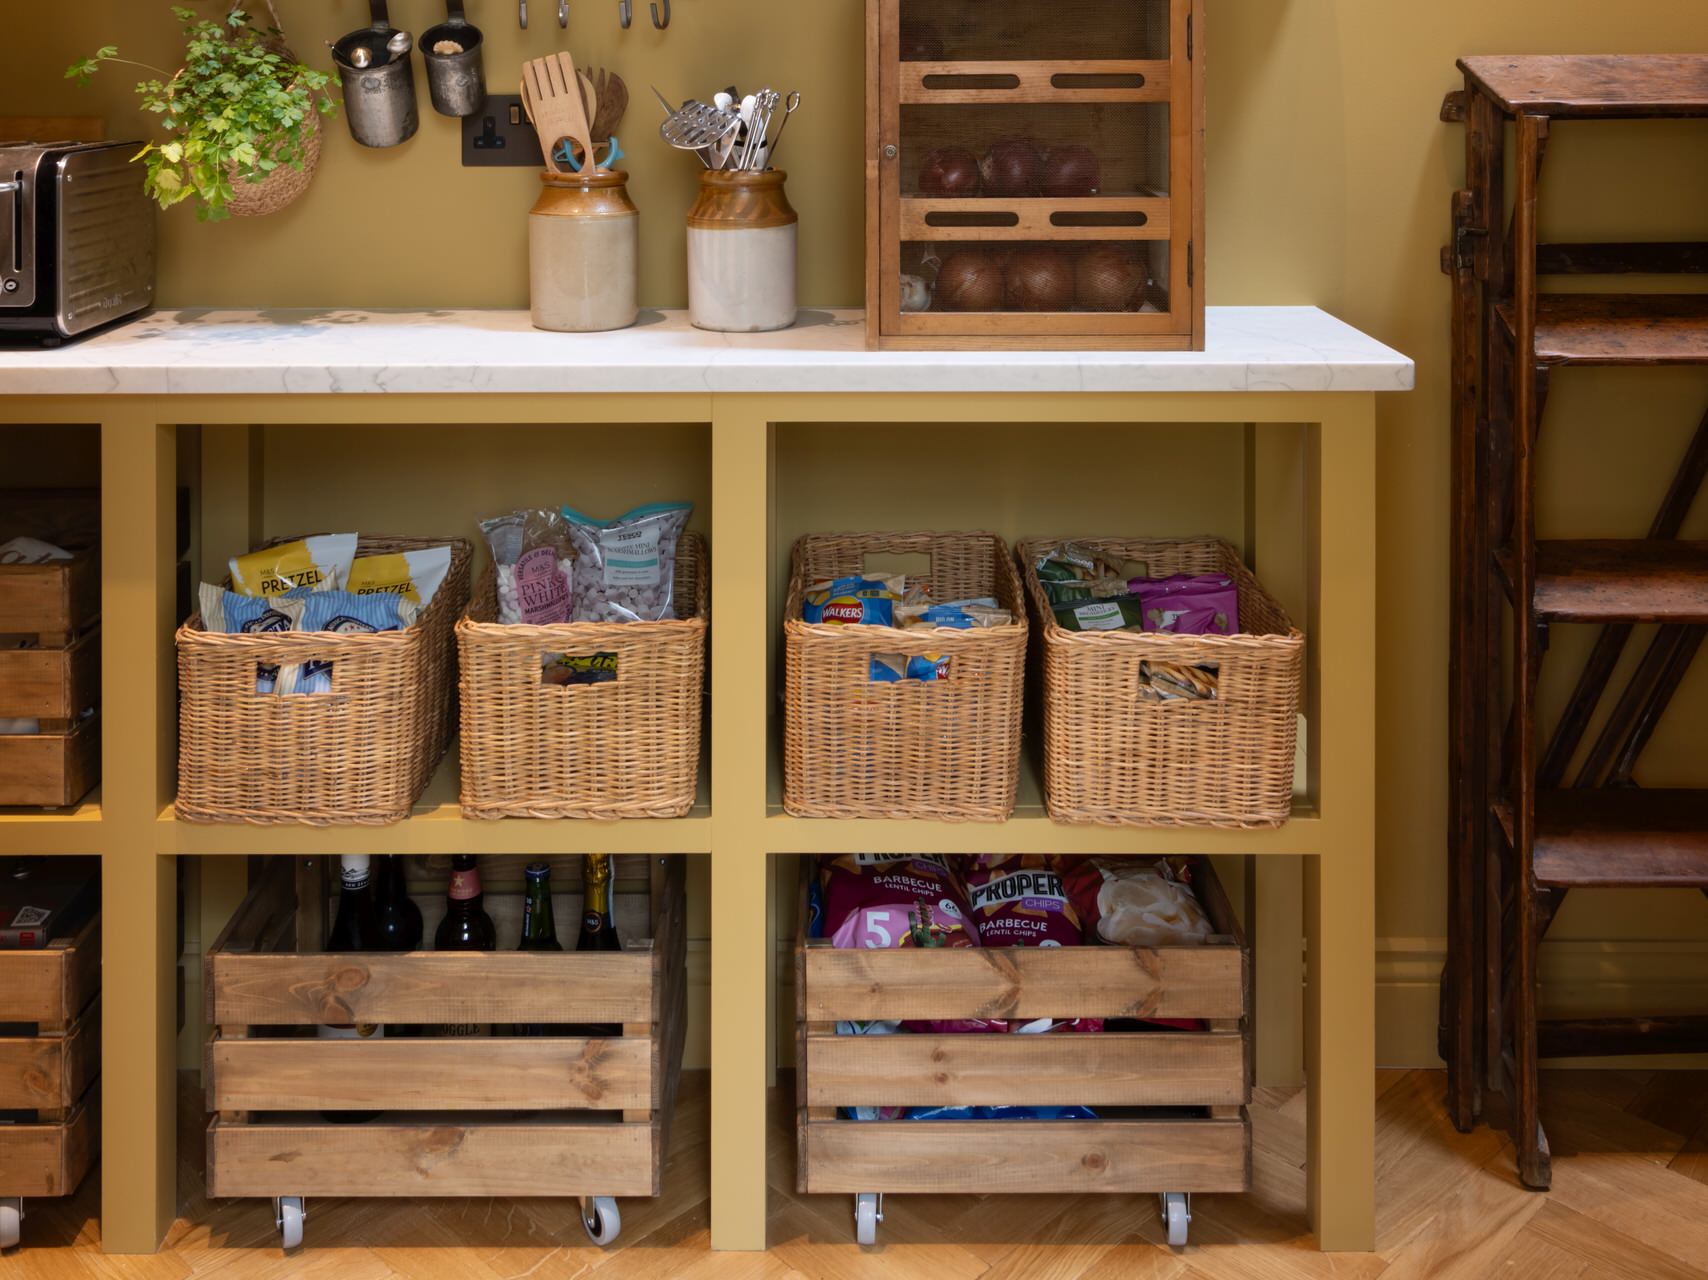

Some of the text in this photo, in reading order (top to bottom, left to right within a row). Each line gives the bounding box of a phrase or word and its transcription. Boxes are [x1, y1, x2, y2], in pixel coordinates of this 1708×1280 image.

[617, 531, 642, 542] TESCO
[261, 569, 322, 594] PRETZEL
[523, 582, 567, 607] WHITE
[822, 605, 862, 619] WALKERS
[873, 874, 943, 898] BARBECUE
[971, 872, 1065, 906] PROPER
[1024, 898, 1061, 911] CHIPS
[978, 917, 1048, 935] BARBECUE
